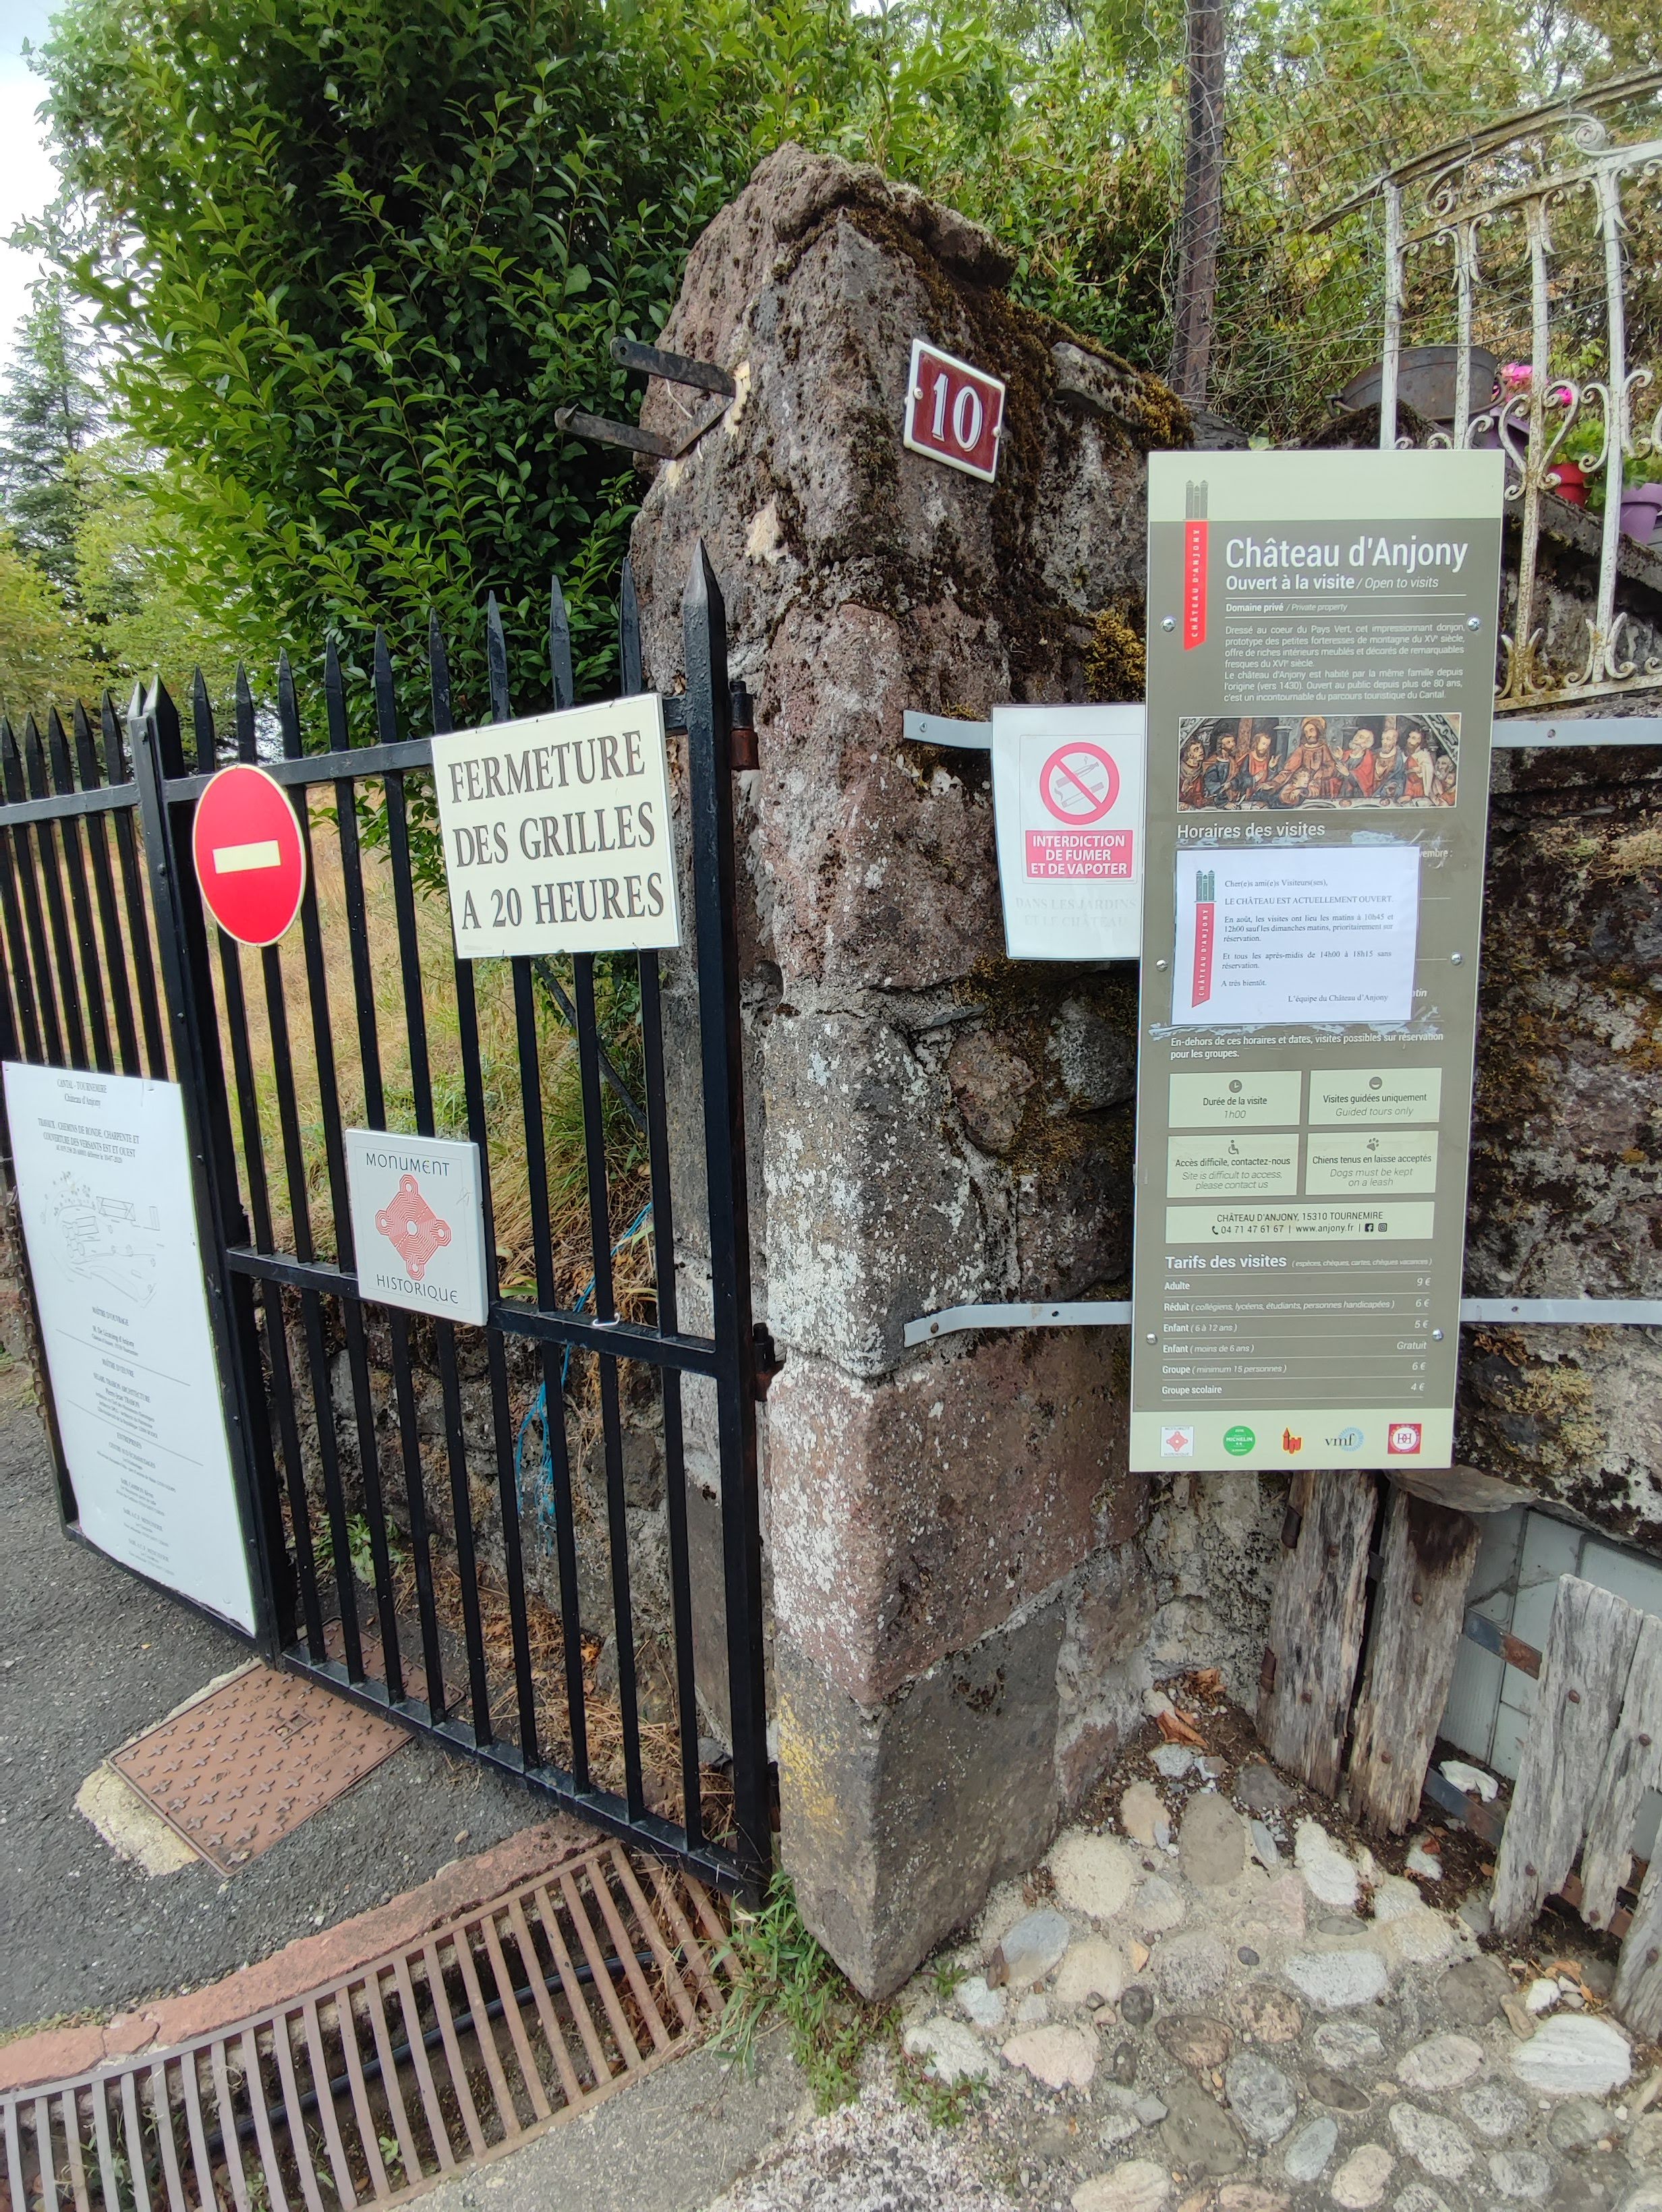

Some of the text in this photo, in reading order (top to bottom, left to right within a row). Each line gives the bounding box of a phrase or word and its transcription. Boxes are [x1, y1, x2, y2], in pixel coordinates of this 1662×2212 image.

[932, 373, 982, 452] 10
[1226, 535, 1468, 573] Château d'Anjony
[1226, 576, 1277, 590] Ouvert
[1282, 575, 1290, 589] à
[1296, 575, 1308, 589] la
[1313, 575, 1354, 589] visite
[1365, 577, 1393, 590] Open
[1397, 578, 1407, 587] to
[1411, 577, 1438, 587] visits
[1190, 588, 1199, 637] CHÂTEAU
[1226, 603, 1261, 612] Domaine
[1264, 603, 1284, 613] privé
[1225, 682, 1255, 692] l'origine
[1257, 682, 1276, 691] (vers
[1280, 681, 1304, 692] 1430).
[1348, 680, 1371, 691] public
[1374, 680, 1399, 691] depuis
[1402, 680, 1419, 689] plus
[1422, 680, 1431, 691] de
[1434, 679, 1443, 690] 80
[449, 730, 645, 804] FERMETURE
[453, 802, 655, 868] DES GRILLES
[1178, 822, 1325, 839] Horaires des visites
[1033, 835, 1125, 847] INTERDICTION
[1046, 850, 1111, 861] DE FUMER
[1031, 863, 1127, 875] ET DE VAPOTER
[462, 873, 664, 929] A 20 HEURES
[1198, 954, 1206, 997] CHÂTEAU
[1357, 994, 1387, 1002] d'Anjony
[1203, 1097, 1228, 1105] Durée
[1240, 1097, 1244, 1105] la
[1323, 1094, 1427, 1104] Visites guidées uniquement
[1225, 1110, 1246, 1118] 1h00
[1336, 1108, 1367, 1116] Guided
[1395, 1107, 1413, 1117] only
[366, 1153, 449, 1176] MONUMENT
[1200, 1158, 1229, 1166] difficile,
[1313, 1156, 1338, 1164] Chiens
[1375, 1155, 1396, 1163] laisse
[1398, 1154, 1431, 1163] acceptés
[1200, 1171, 1207, 1180] is
[1209, 1171, 1239, 1180] difficult
[1330, 1168, 1412, 1179] Dogs must be kept
[1195, 1182, 1223, 1191] please
[1370, 1177, 1393, 1186] leash
[1217, 1213, 1255, 1222] CHÂTEAU
[1257, 1213, 1299, 1221] D'ANJONY,
[1296, 1223, 1353, 1233] www.anjony.fr
[1165, 1254, 1286, 1269] Tarifs des visites
[376, 1275, 459, 1304] HISTORIQUE
[1165, 1281, 1190, 1289] Adulte
[1162, 1387, 1190, 1395] Groupe
[1192, 1385, 1222, 1393] scolaire
